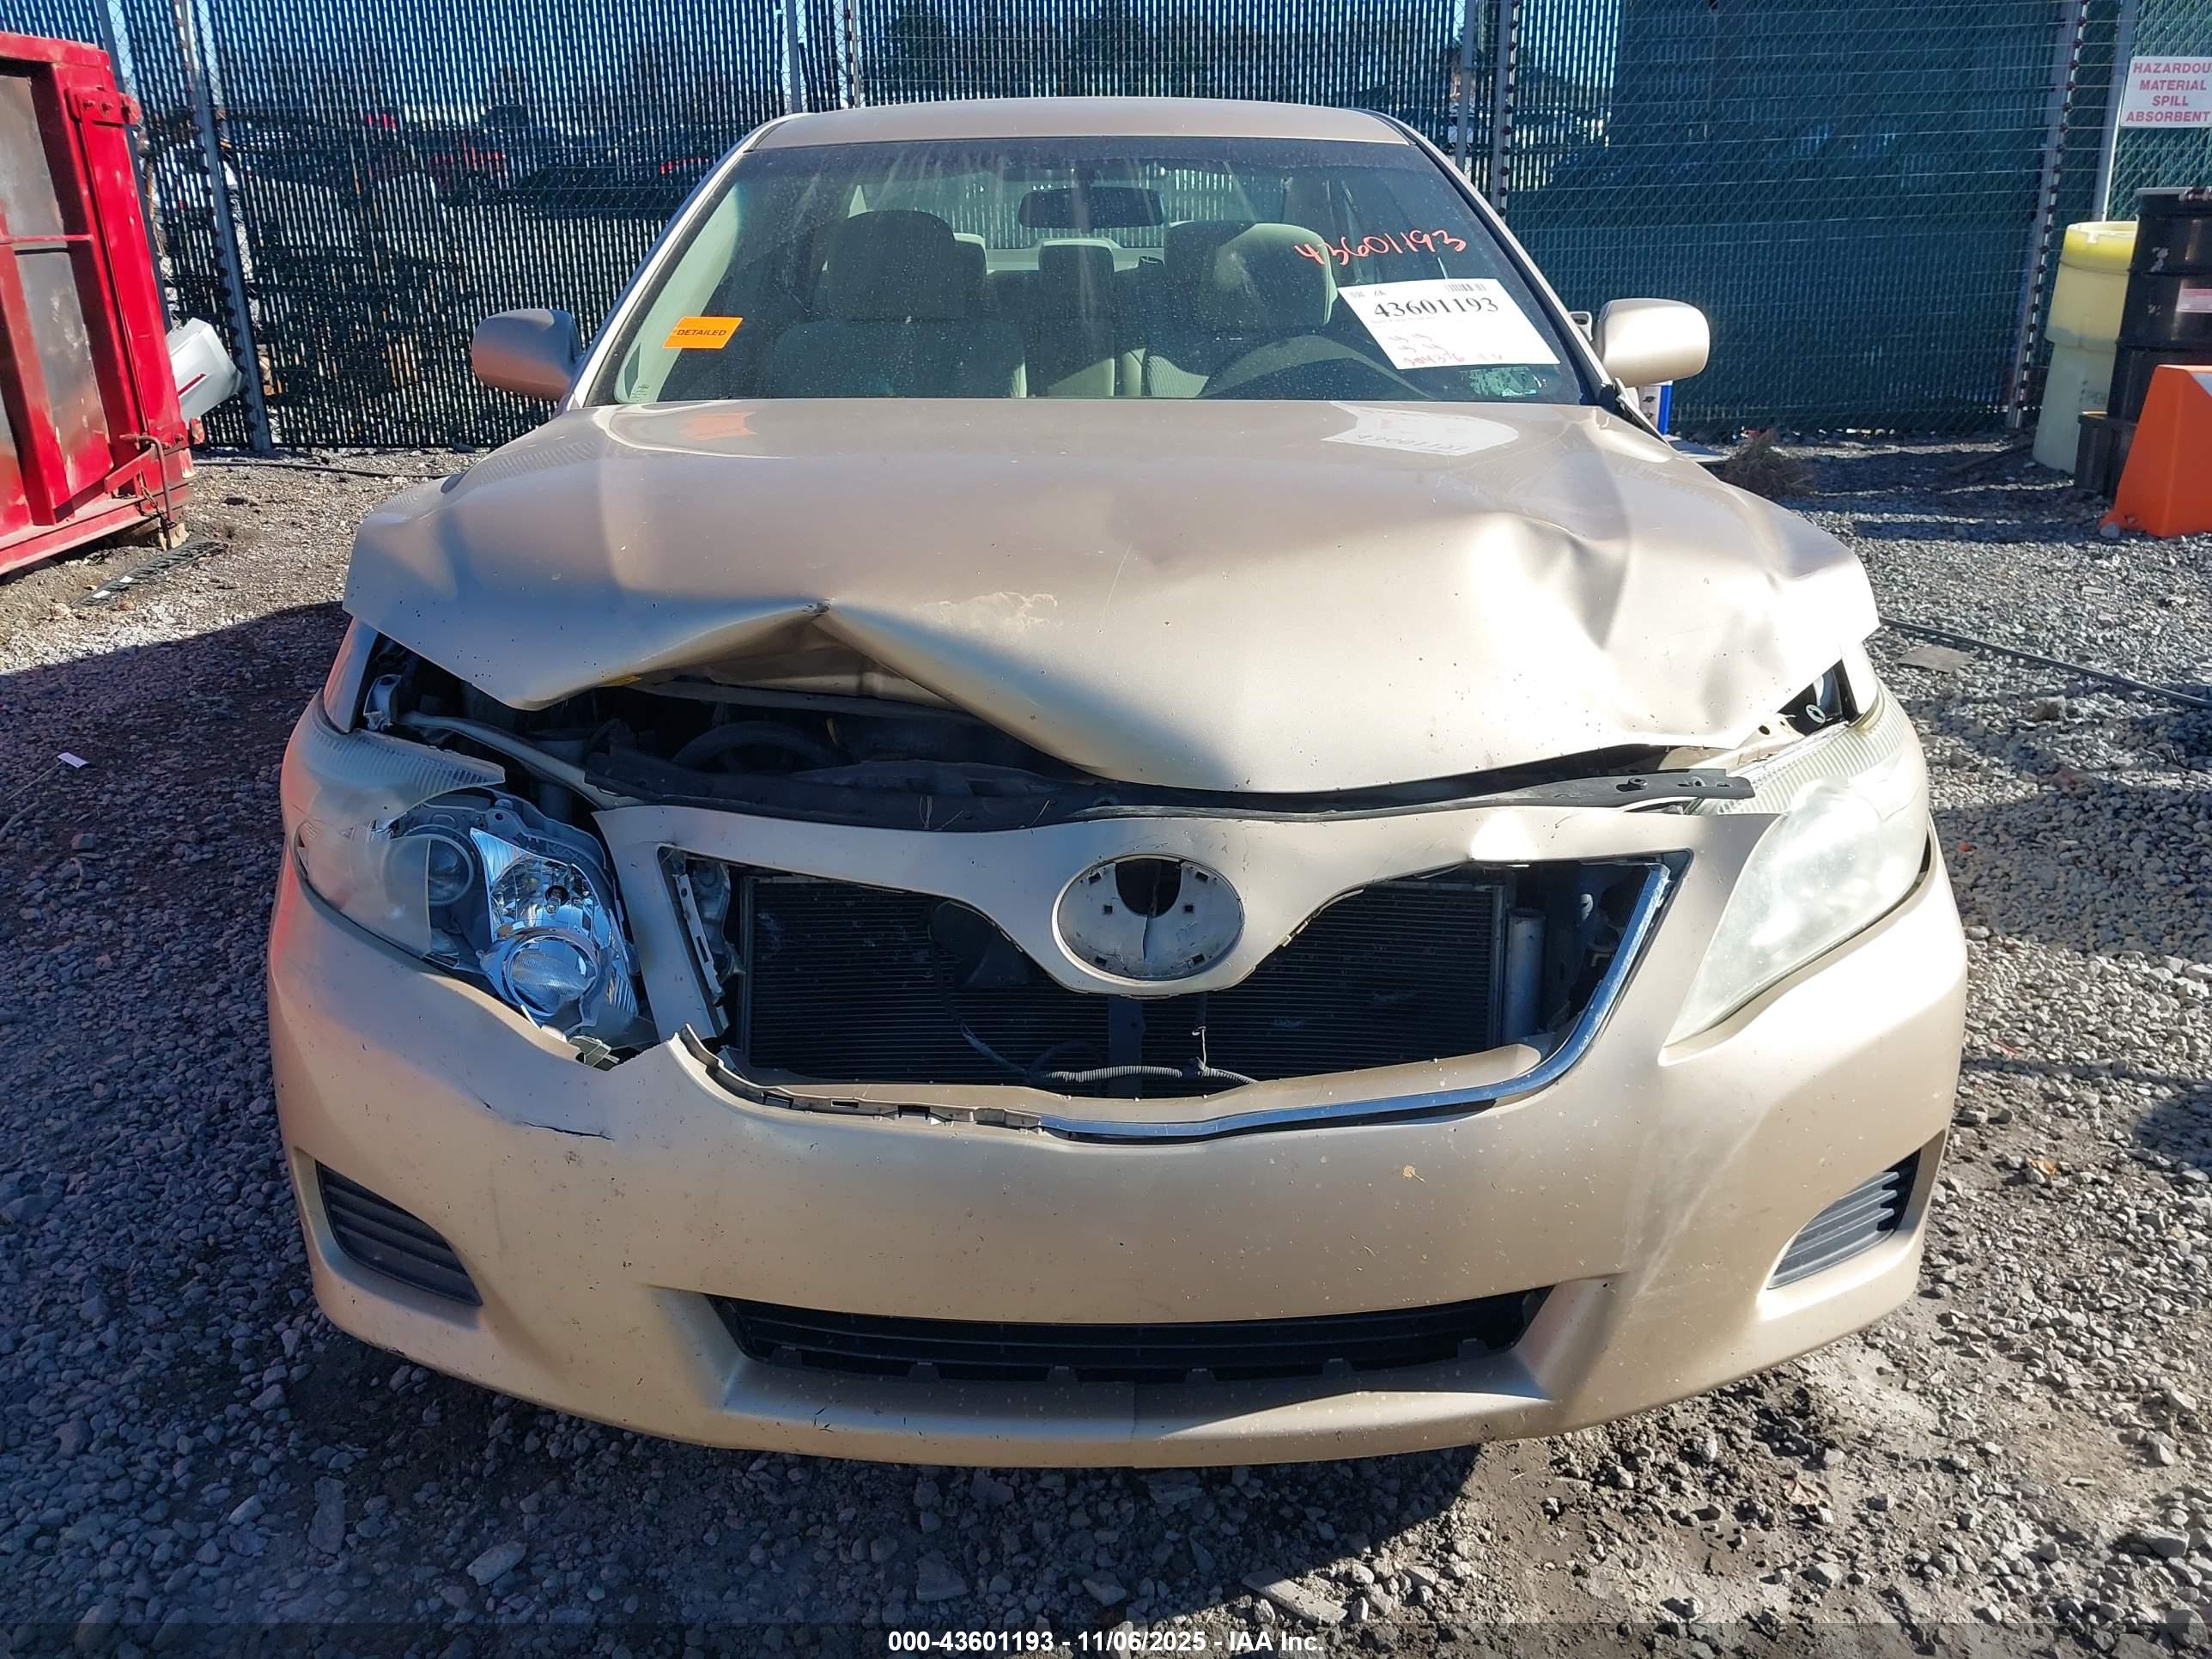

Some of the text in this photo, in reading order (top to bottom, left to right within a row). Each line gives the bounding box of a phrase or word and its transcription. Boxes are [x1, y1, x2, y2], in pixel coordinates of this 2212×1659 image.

[2133, 63, 2212, 74] HAZARDOU
[2139, 80, 2207, 91] MATERIAL
[2152, 95, 2189, 106] SPILL
[2126, 111, 2211, 123] ABSORBENT
[1293, 229, 1467, 265] 43601193
[1375, 297, 1499, 317] 43601193
